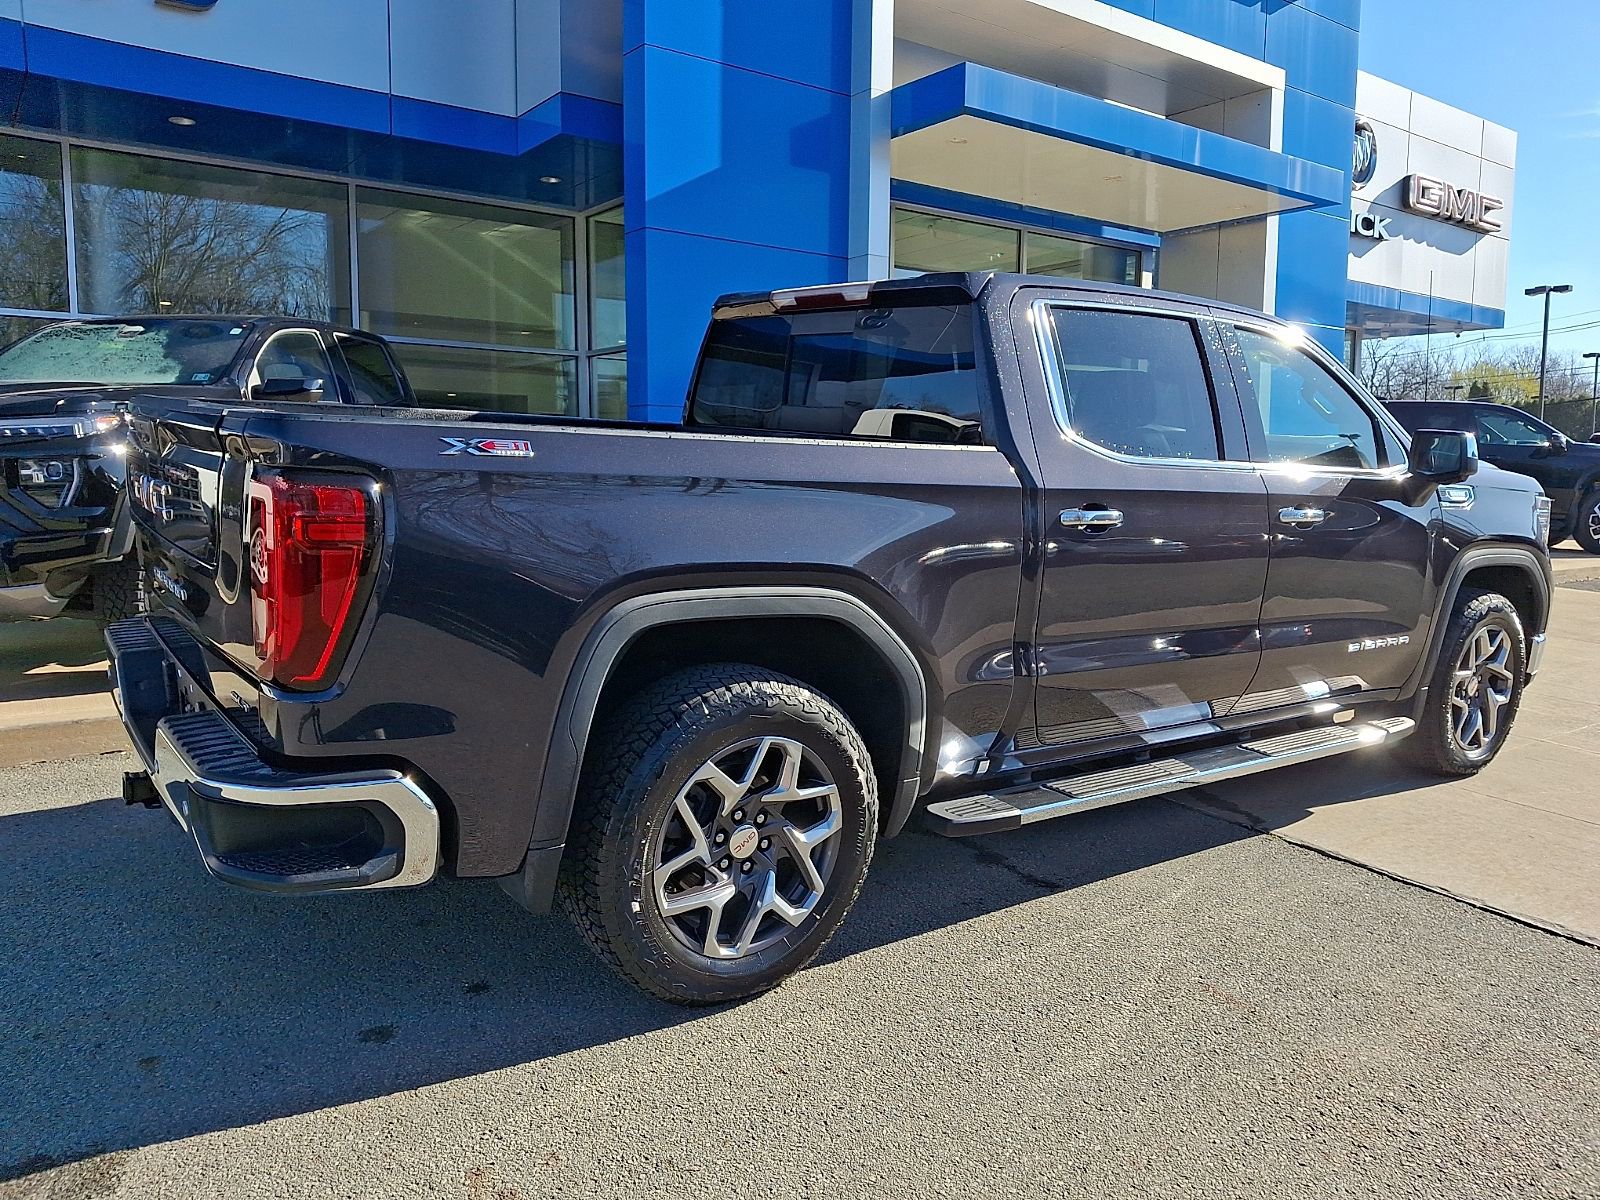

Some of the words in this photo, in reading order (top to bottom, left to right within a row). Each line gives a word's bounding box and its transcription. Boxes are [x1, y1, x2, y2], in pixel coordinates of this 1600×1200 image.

[1408, 174, 1504, 232] GMC
[1347, 636, 1410, 653] SIERRA
[733, 831, 756, 854] GMC
